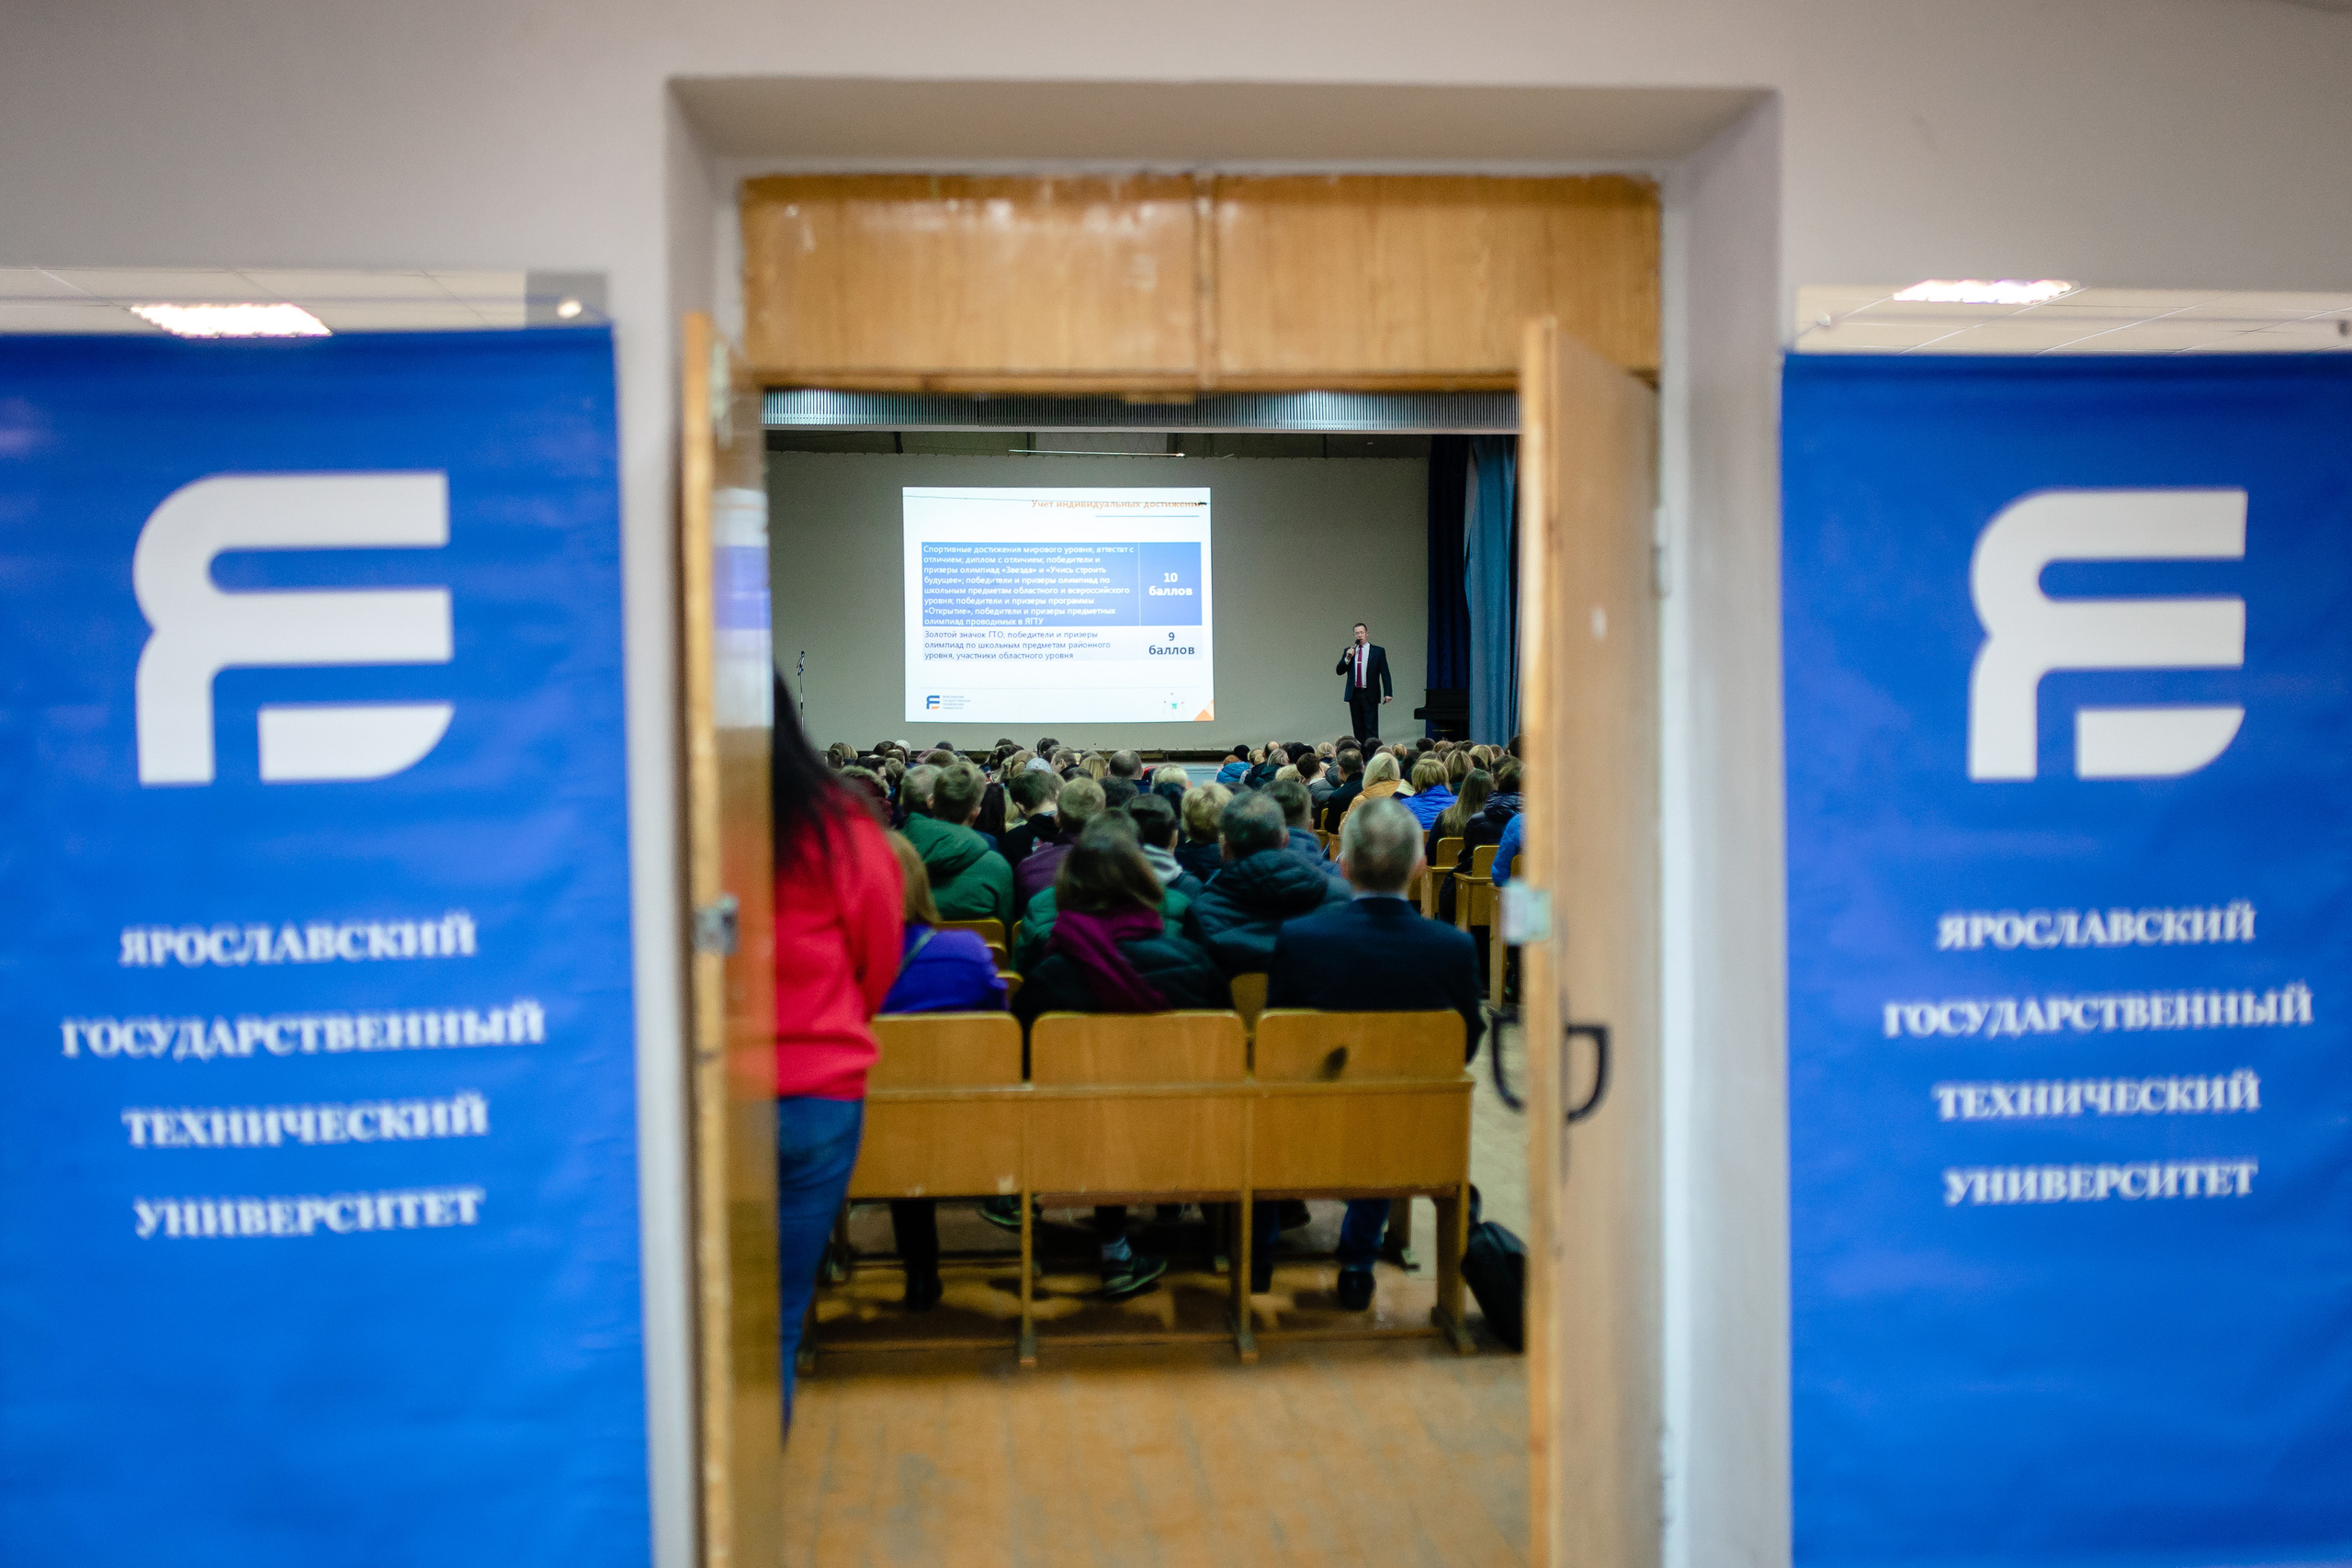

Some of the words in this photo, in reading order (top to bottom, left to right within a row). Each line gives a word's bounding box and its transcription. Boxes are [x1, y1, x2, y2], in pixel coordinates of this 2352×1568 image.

[1056, 501, 1140, 510] индивидуальных
[923, 545, 971, 554] Спортивные
[924, 576, 964, 585] будущее»;
[1164, 572, 1178, 583] 10
[1068, 587, 1130, 595] всероссийского
[1149, 586, 1193, 596] баллов
[924, 607, 973, 616] «Открытие»,
[1168, 632, 1175, 641] 9
[1069, 641, 1110, 649] районного
[1149, 645, 1195, 655] баллов
[1937, 899, 2256, 950] ЯРОСЛАВСКИЙ
[119, 908, 478, 966] ЯРОСЛАВСКИЙ
[1883, 980, 2314, 1038] ГОСУДАРСТВЕННЫЙ
[60, 998, 547, 1061] ГОСУДАРСТВЕННЫЙ
[1936, 1068, 2261, 1121] ТЕХНИЧЕСКИЙ
[121, 1089, 489, 1147] ТЕХНИЧЕСКИЙ
[1942, 1157, 2258, 1206] УНИВЕРСИТЕТ
[133, 1186, 486, 1239] УНИВЕРСИТЕТ
